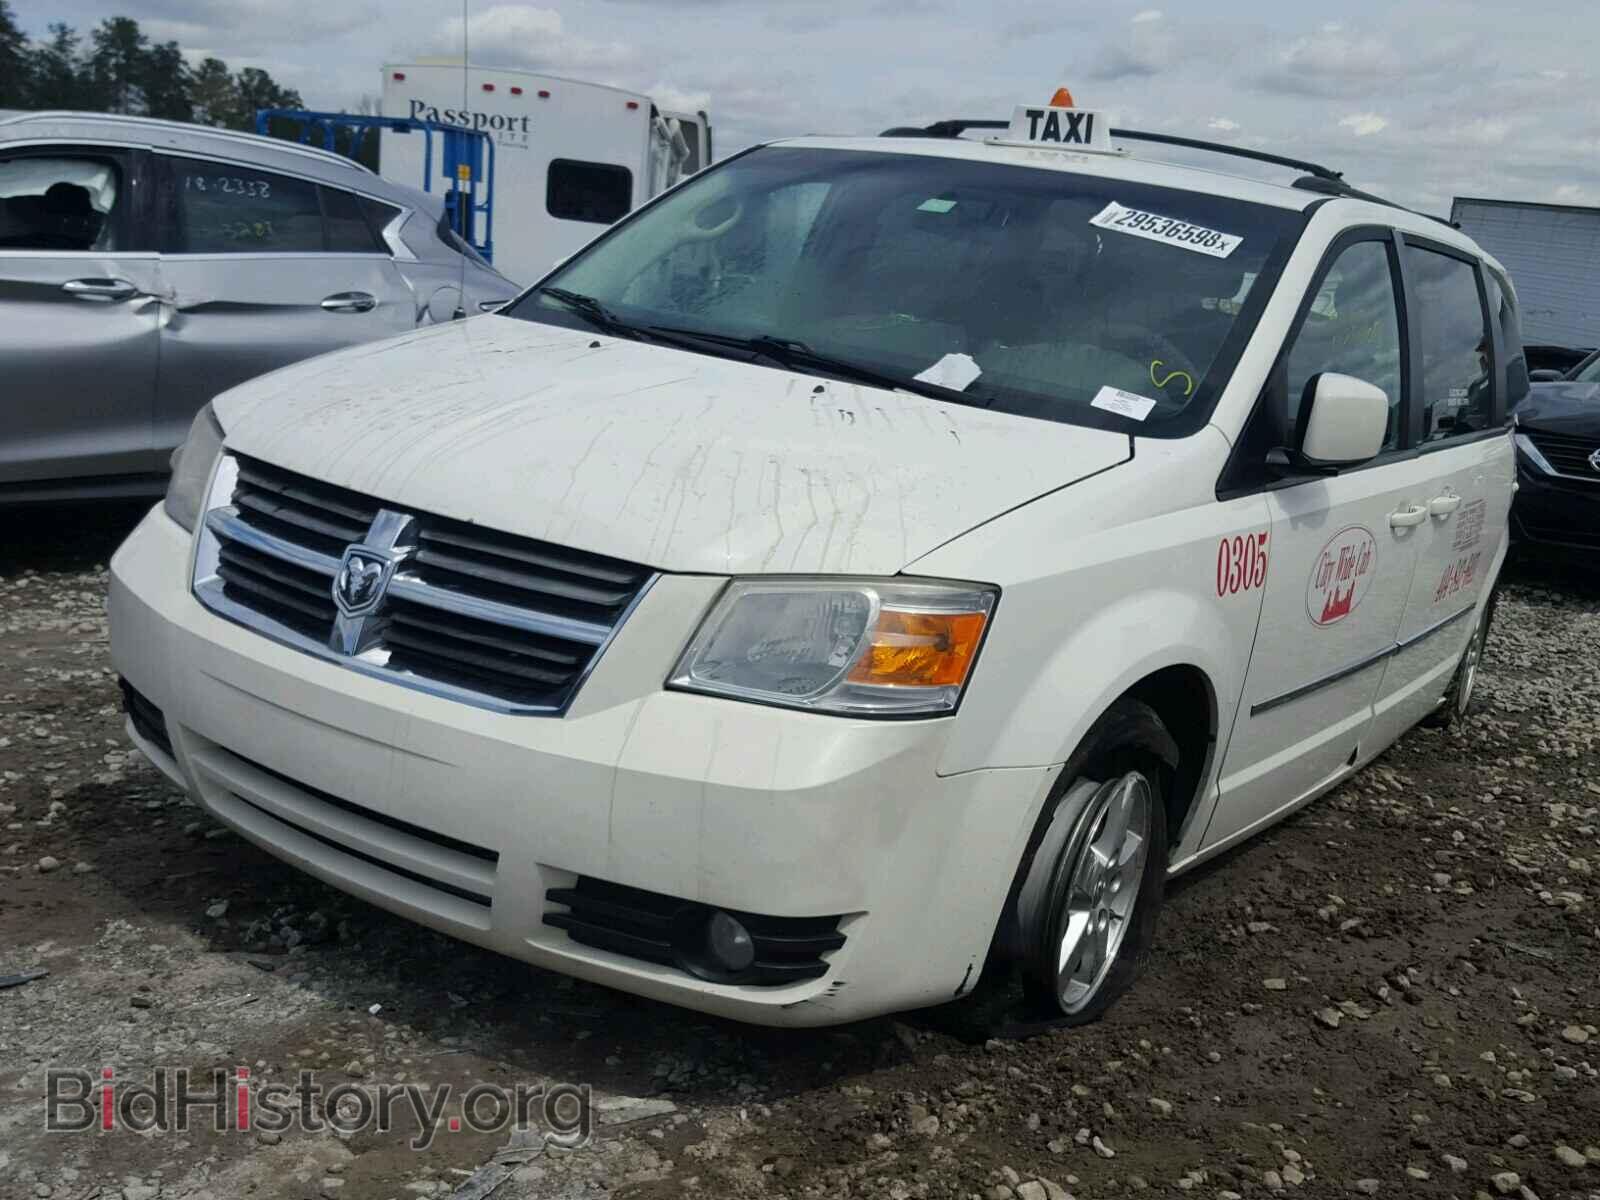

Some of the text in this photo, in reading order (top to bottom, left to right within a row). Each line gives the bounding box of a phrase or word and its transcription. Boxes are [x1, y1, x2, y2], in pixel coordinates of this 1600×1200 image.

[409, 99, 530, 133] Passport
[1025, 109, 1094, 144] TAXI
[1217, 530, 1268, 597] 0305
[1315, 551, 1336, 594] City
[1336, 545, 1356, 581] Wide
